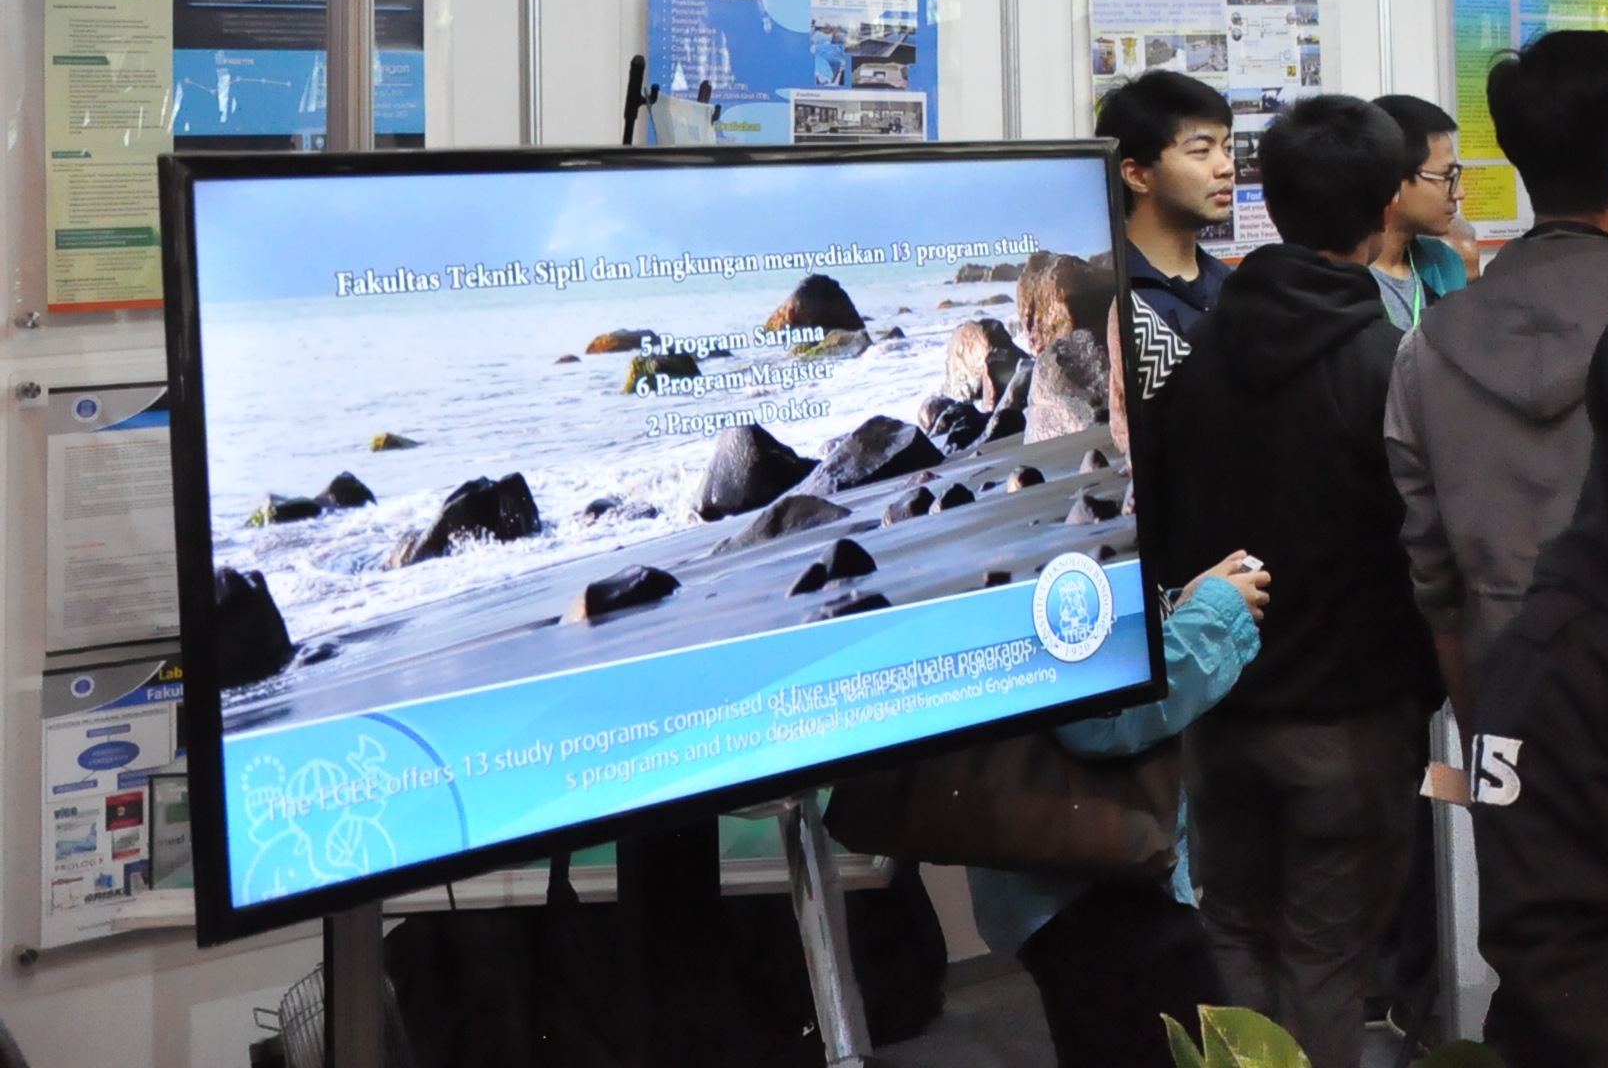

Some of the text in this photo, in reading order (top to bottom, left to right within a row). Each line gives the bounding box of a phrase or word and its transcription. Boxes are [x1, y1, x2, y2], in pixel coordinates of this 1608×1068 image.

[335, 234, 1041, 297] Fakultas Teknik Sipil dan Lingkungan menyediakan 13 program studi:
[640, 324, 825, 358] 5 Program Sarjana
[635, 361, 834, 398] 6 Program Magister
[646, 397, 831, 437] 2 Program Doktor
[1065, 642, 1090, 657] 1920
[159, 667, 183, 680] Lab
[986, 667, 1057, 694] Engineering
[147, 683, 184, 700] Fakul
[264, 792, 311, 823] The
[318, 782, 379, 812] FCEE
[387, 763, 455, 794] offers
[460, 754, 490, 778] 13
[495, 741, 555, 771] study
[560, 718, 660, 762] programs
[664, 697, 763, 741] comprised
[767, 687, 785, 710] of
[828, 654, 953, 697] undergraduate
[582, 751, 681, 791] programs
[685, 734, 721, 761] and
[726, 727, 763, 753] two
